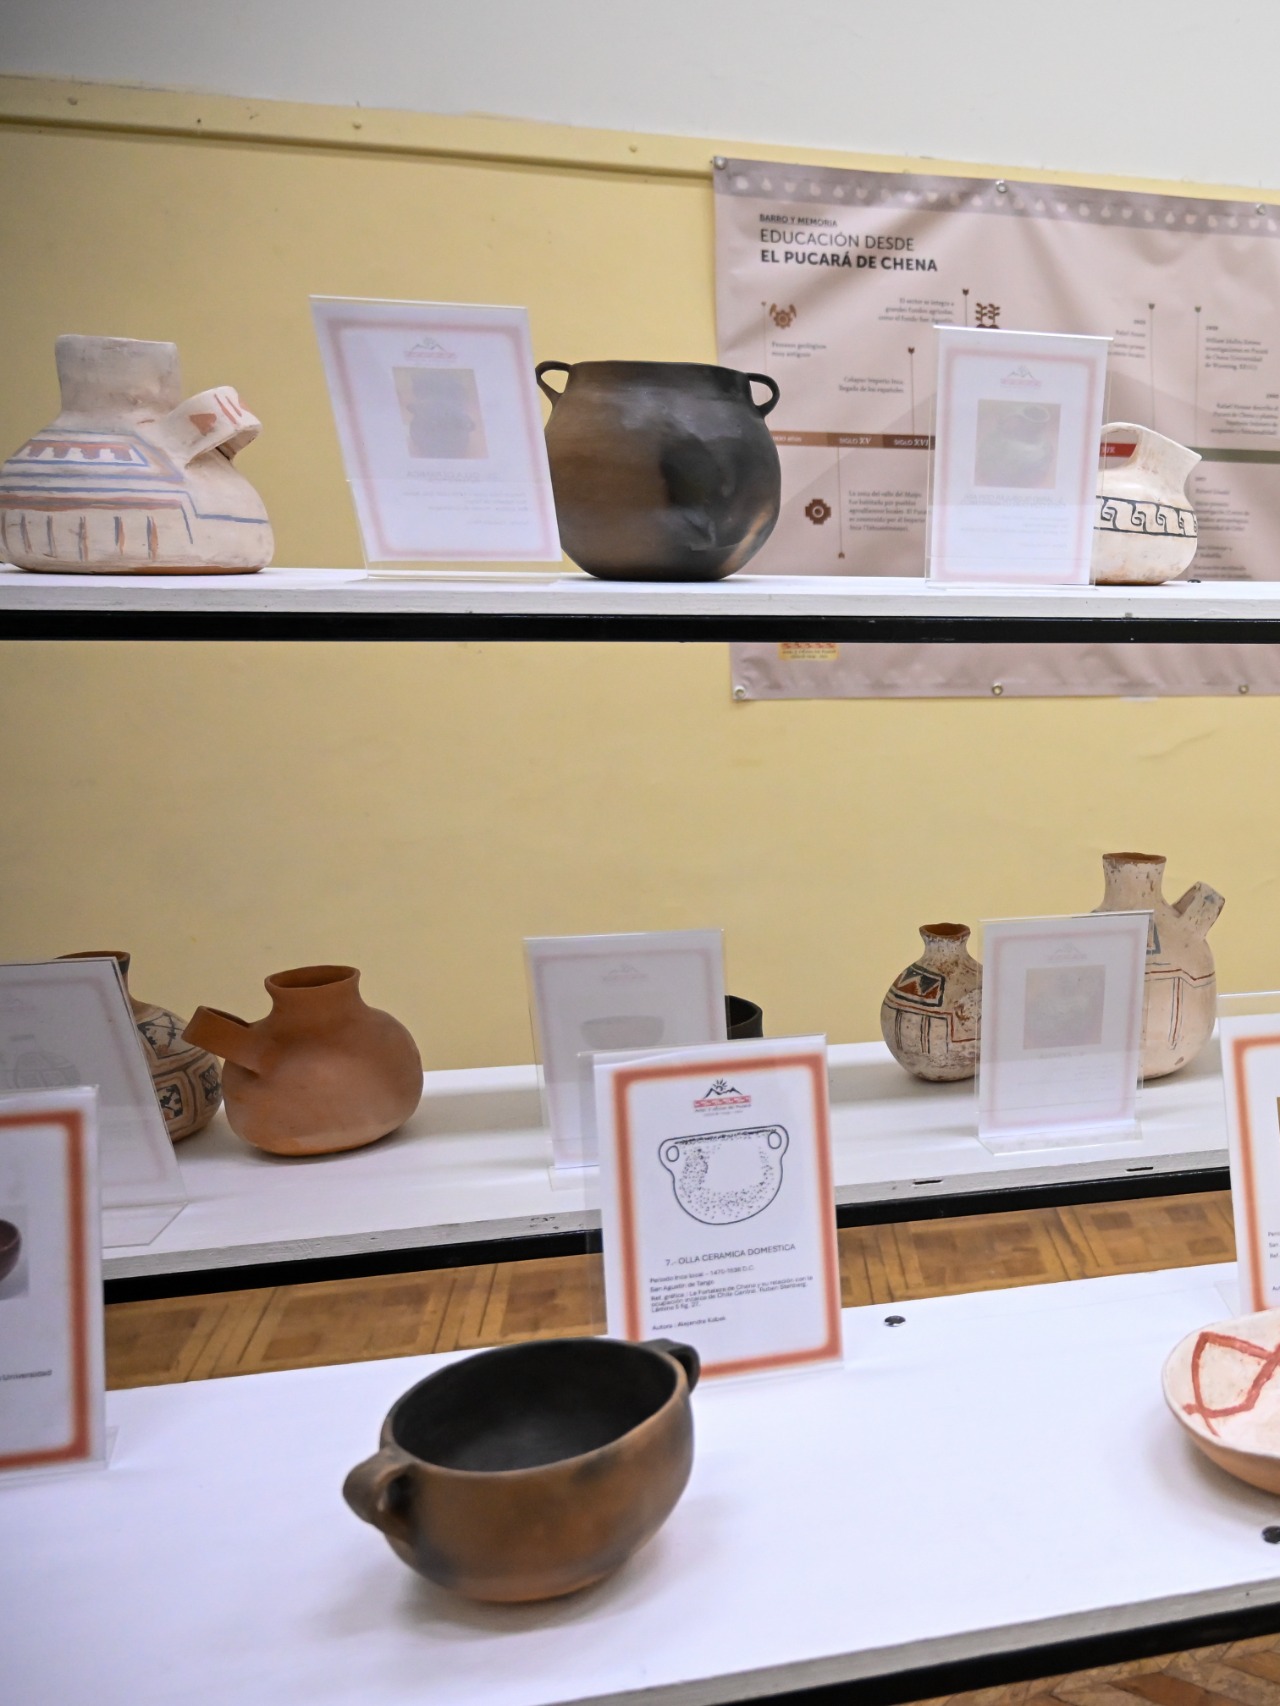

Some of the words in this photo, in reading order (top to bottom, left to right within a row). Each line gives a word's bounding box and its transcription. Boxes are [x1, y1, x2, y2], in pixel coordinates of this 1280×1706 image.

[760, 214, 789, 224] BARRO
[798, 217, 838, 227] MEMORIA
[760, 229, 860, 248] EDUCACIÓN
[865, 235, 915, 251] DESDE
[761, 250, 780, 263] EL
[784, 251, 852, 268] PUCARÁ
[857, 256, 877, 269] DE
[881, 257, 938, 272] CHENA
[678, 1256, 700, 1265] OLLA
[702, 1250, 746, 1262] CERAMICA
[747, 1243, 796, 1256] DOMESTICA
